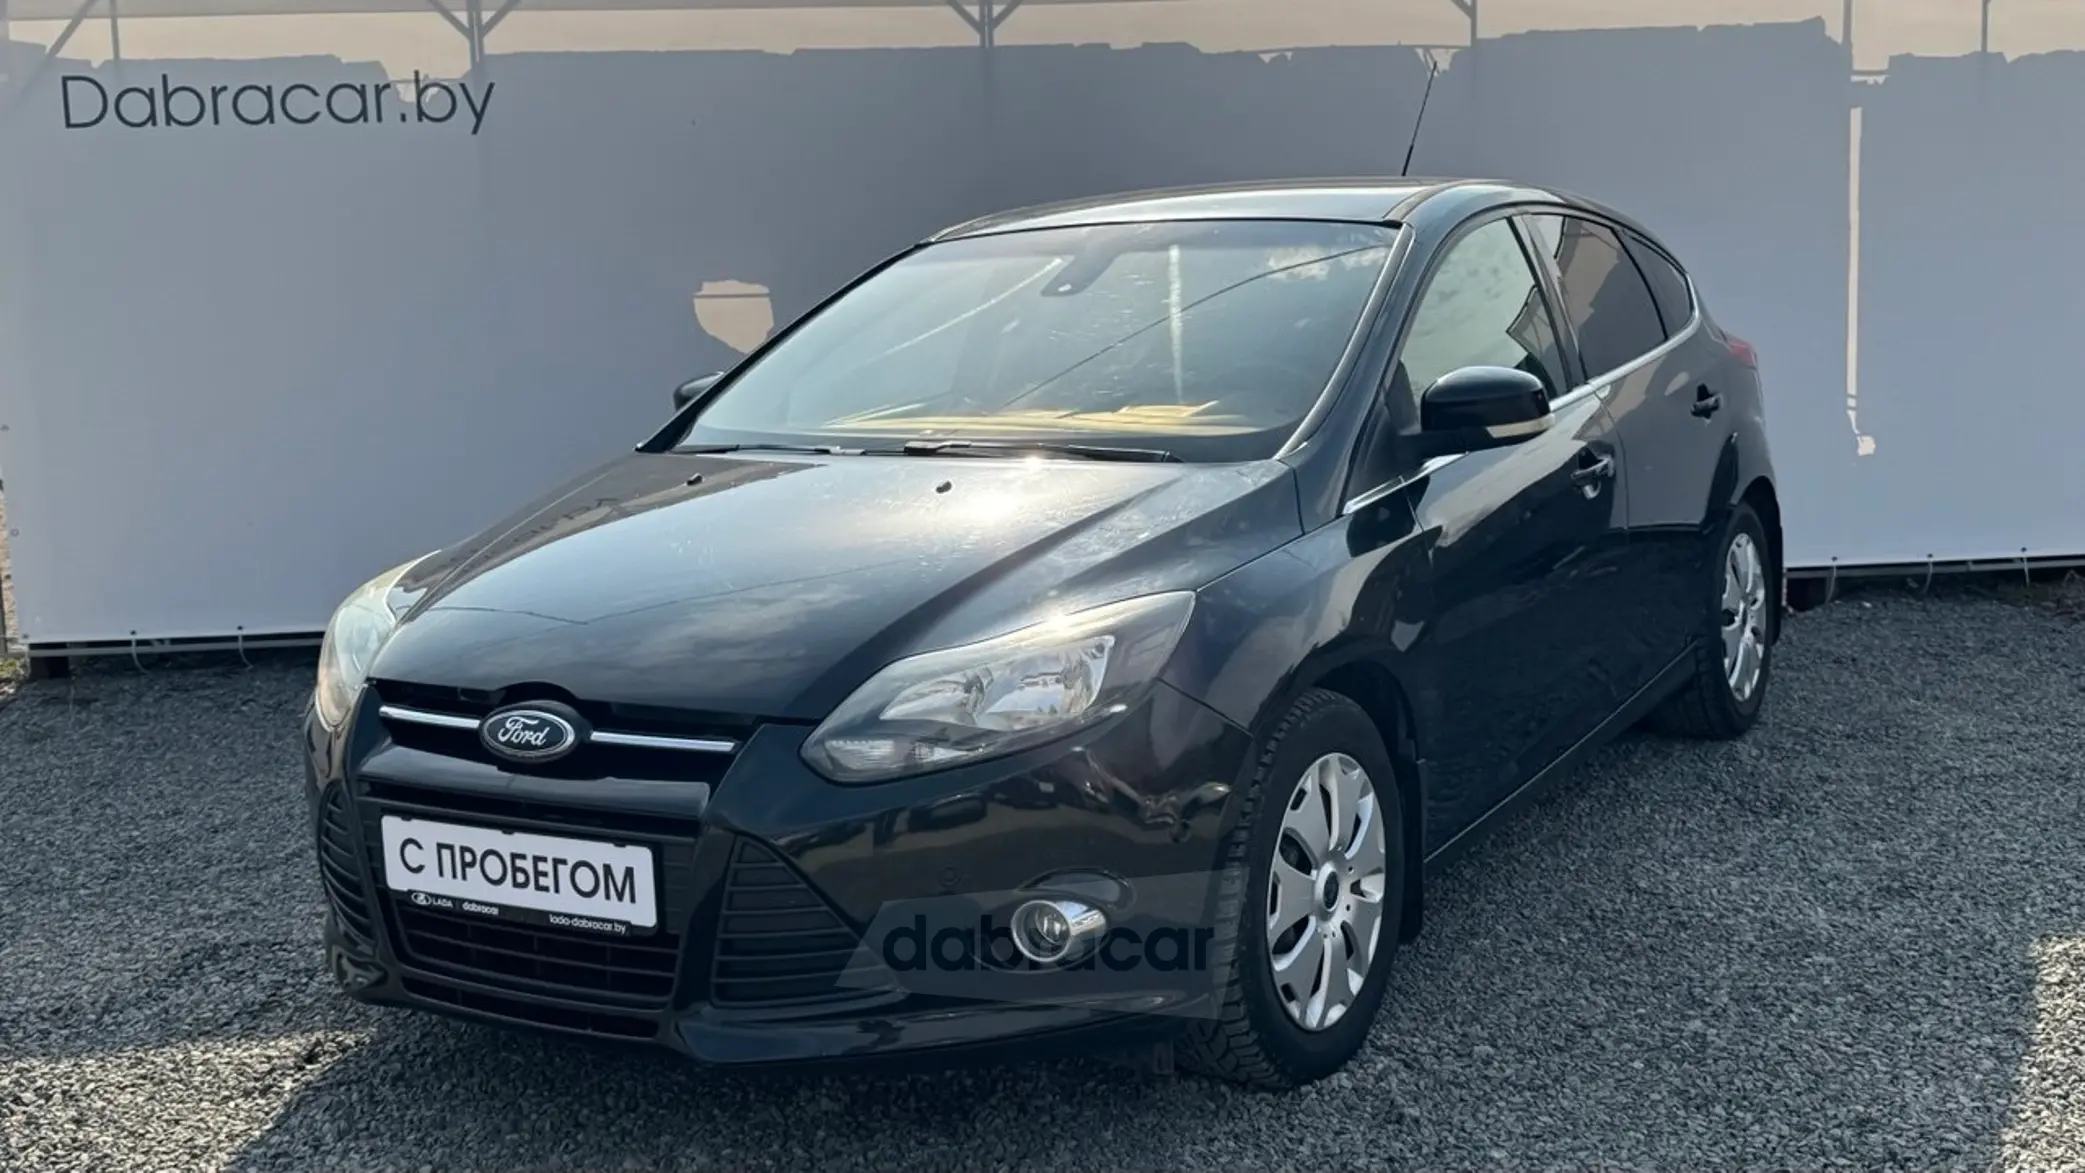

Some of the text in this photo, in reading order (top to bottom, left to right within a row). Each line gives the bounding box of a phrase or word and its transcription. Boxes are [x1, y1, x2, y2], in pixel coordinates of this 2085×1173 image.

[61, 69, 495, 135] Dabracar.by
[498, 716, 549, 746] Ford
[400, 838, 636, 904] С ПРОБЕГОМ
[432, 897, 454, 909] LADA
